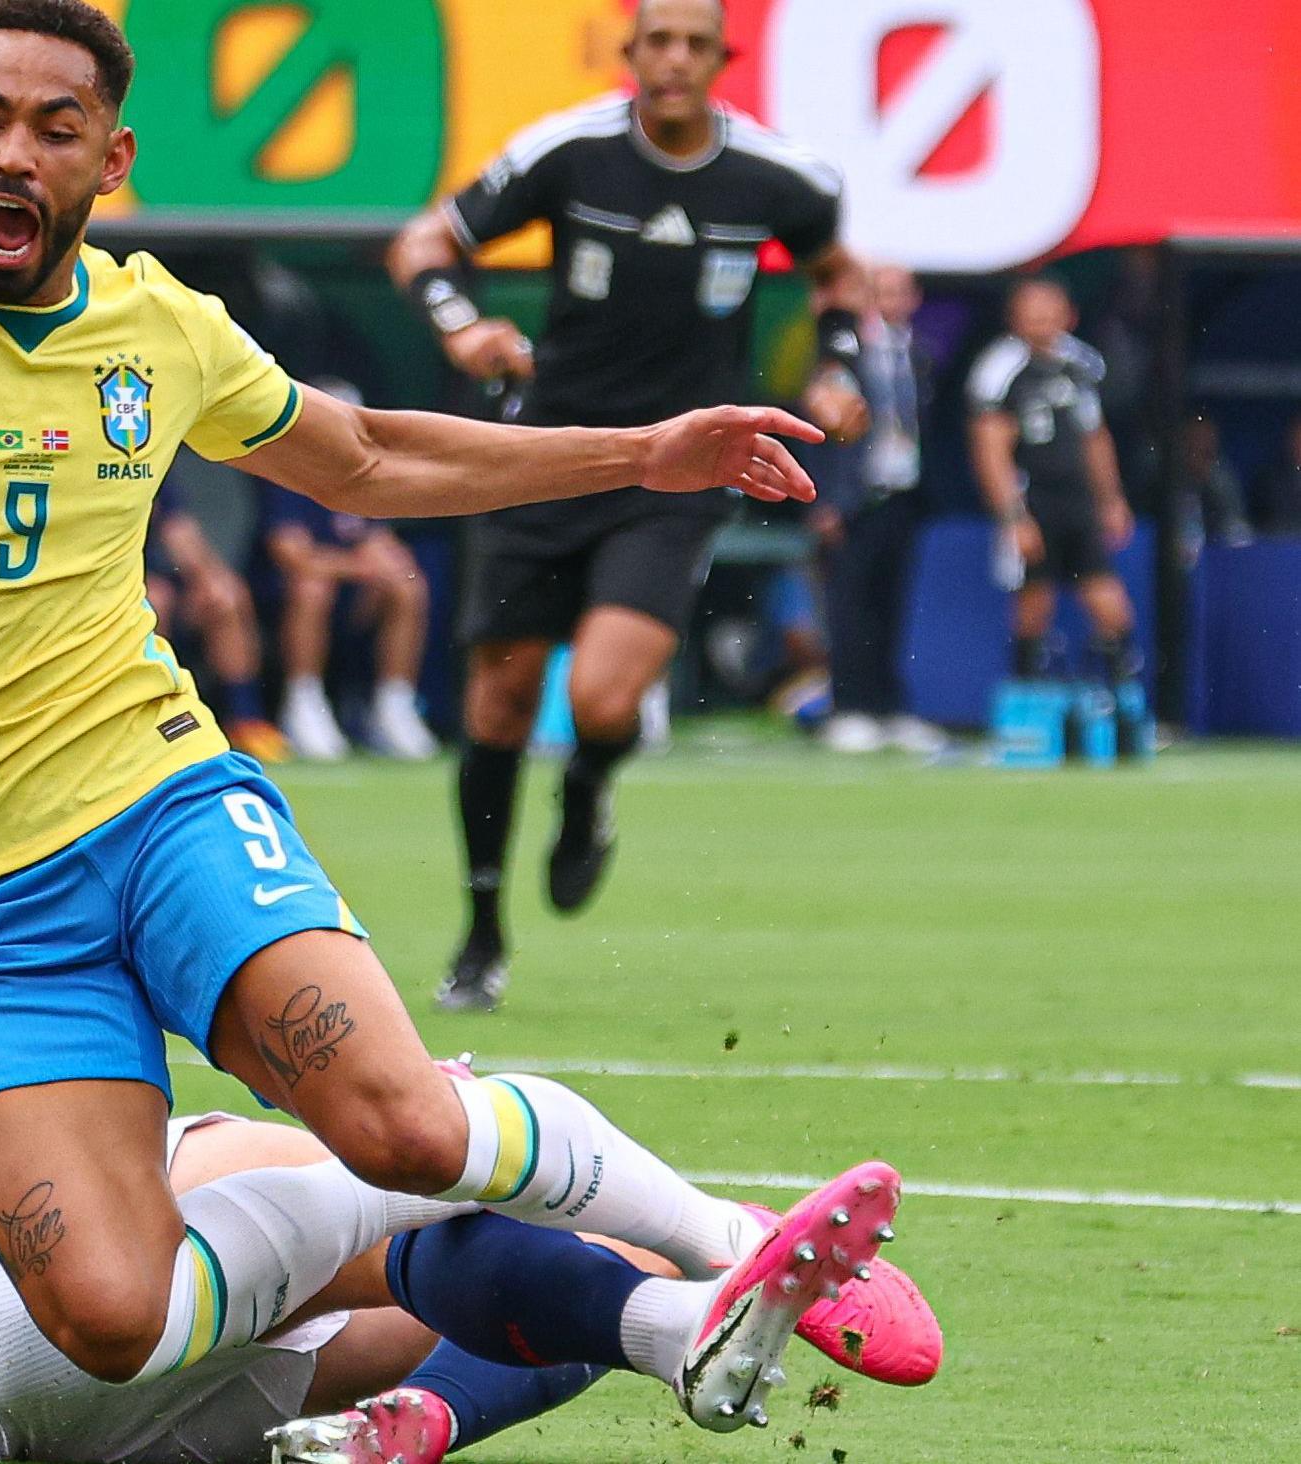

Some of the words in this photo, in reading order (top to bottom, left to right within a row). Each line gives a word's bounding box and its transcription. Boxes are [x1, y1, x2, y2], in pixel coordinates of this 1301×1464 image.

[116, 403, 137, 414] CBF
[97, 463, 154, 480] BRASIL
[222, 792, 288, 870] 9
[565, 1146, 603, 1217] BRASIL
